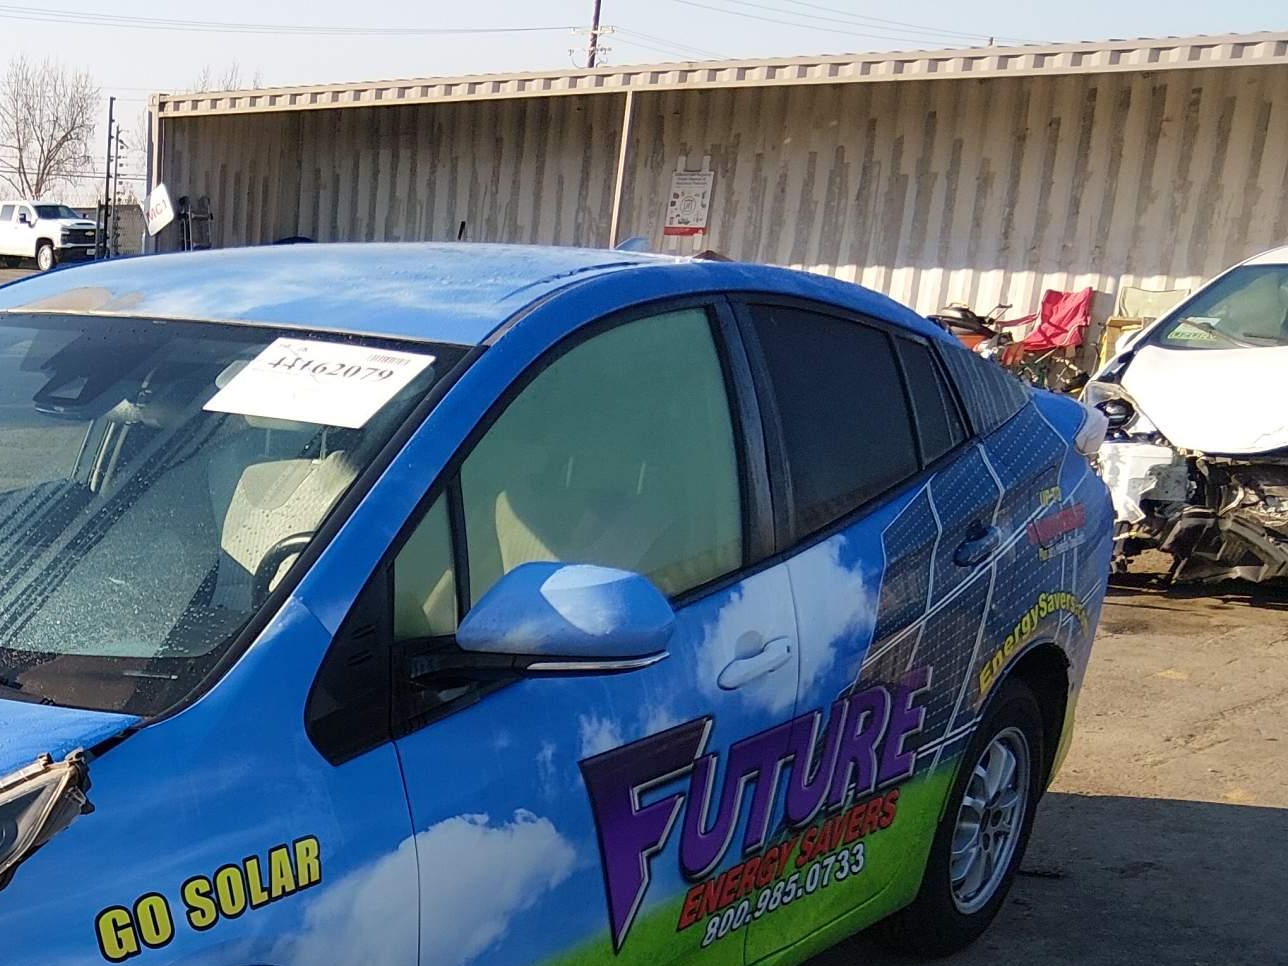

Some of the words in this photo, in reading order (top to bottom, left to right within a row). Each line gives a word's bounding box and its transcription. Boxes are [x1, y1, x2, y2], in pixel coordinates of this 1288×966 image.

[268, 356, 395, 381] 44162079
[577, 665, 934, 957] FUTURE
[676, 832, 799, 932] ENERGY
[796, 788, 900, 868] SAVERS
[95, 892, 175, 963] GO
[181, 834, 322, 931] SOLAR
[700, 842, 865, 949] 800.985.0733
